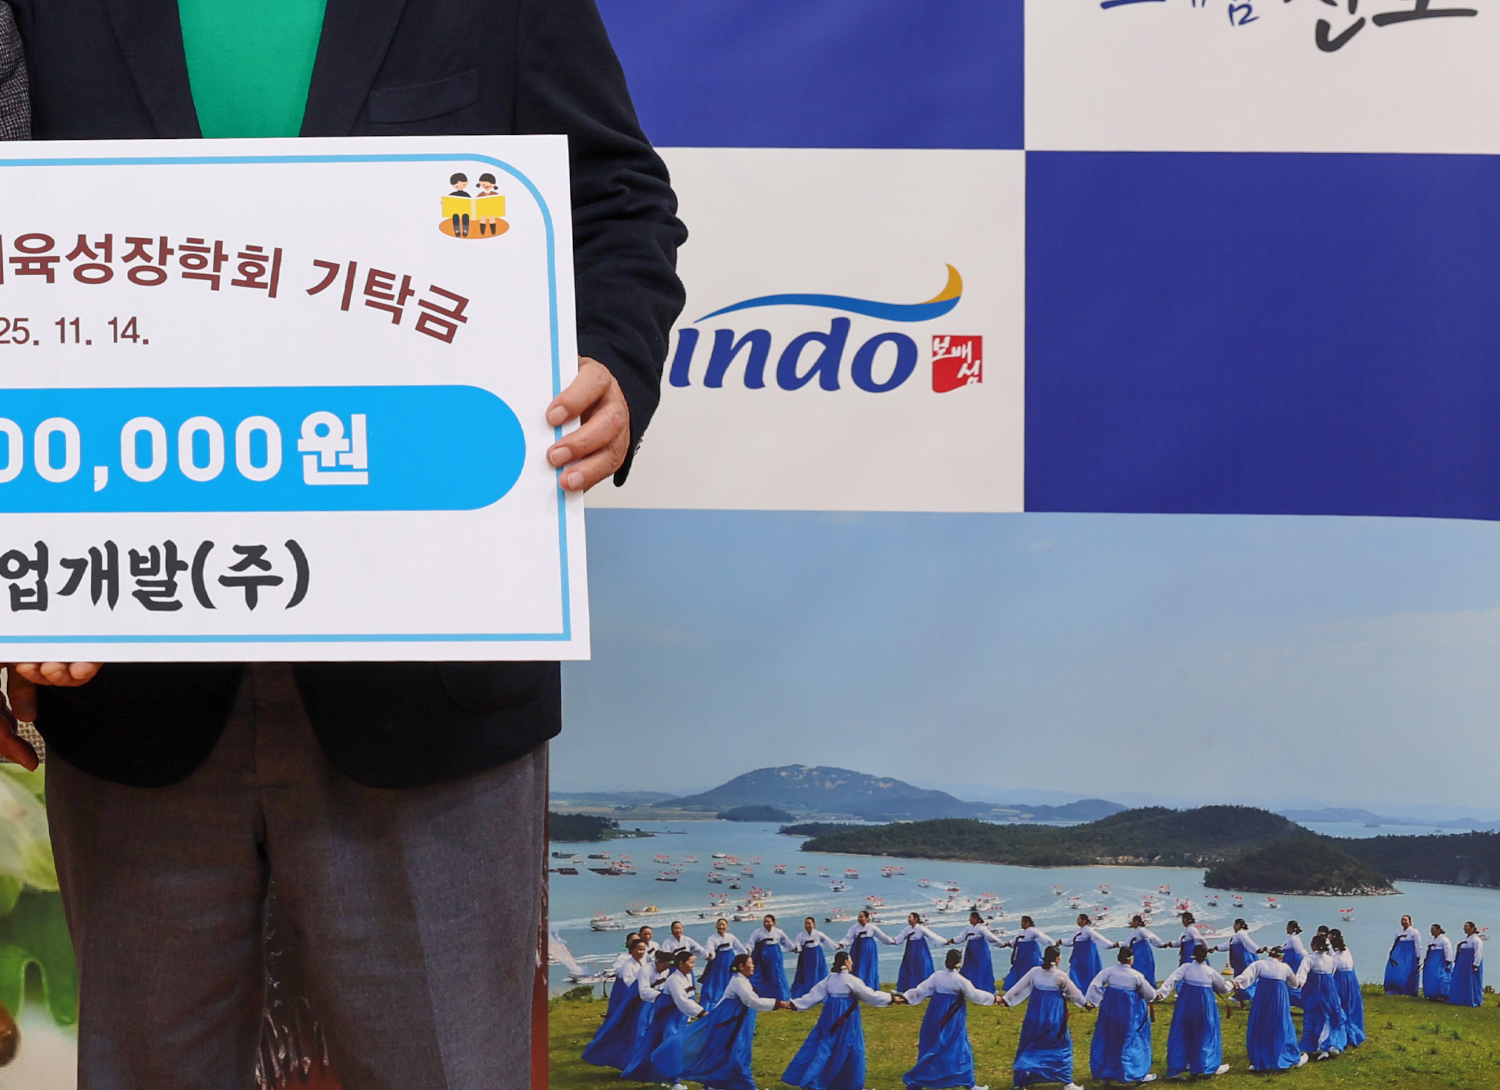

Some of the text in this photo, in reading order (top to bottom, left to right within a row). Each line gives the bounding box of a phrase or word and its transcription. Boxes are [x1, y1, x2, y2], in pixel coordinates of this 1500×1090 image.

[305, 256, 470, 344] 기탁금
[55, 317, 92, 346] 11.
[107, 316, 150, 346] 14.
